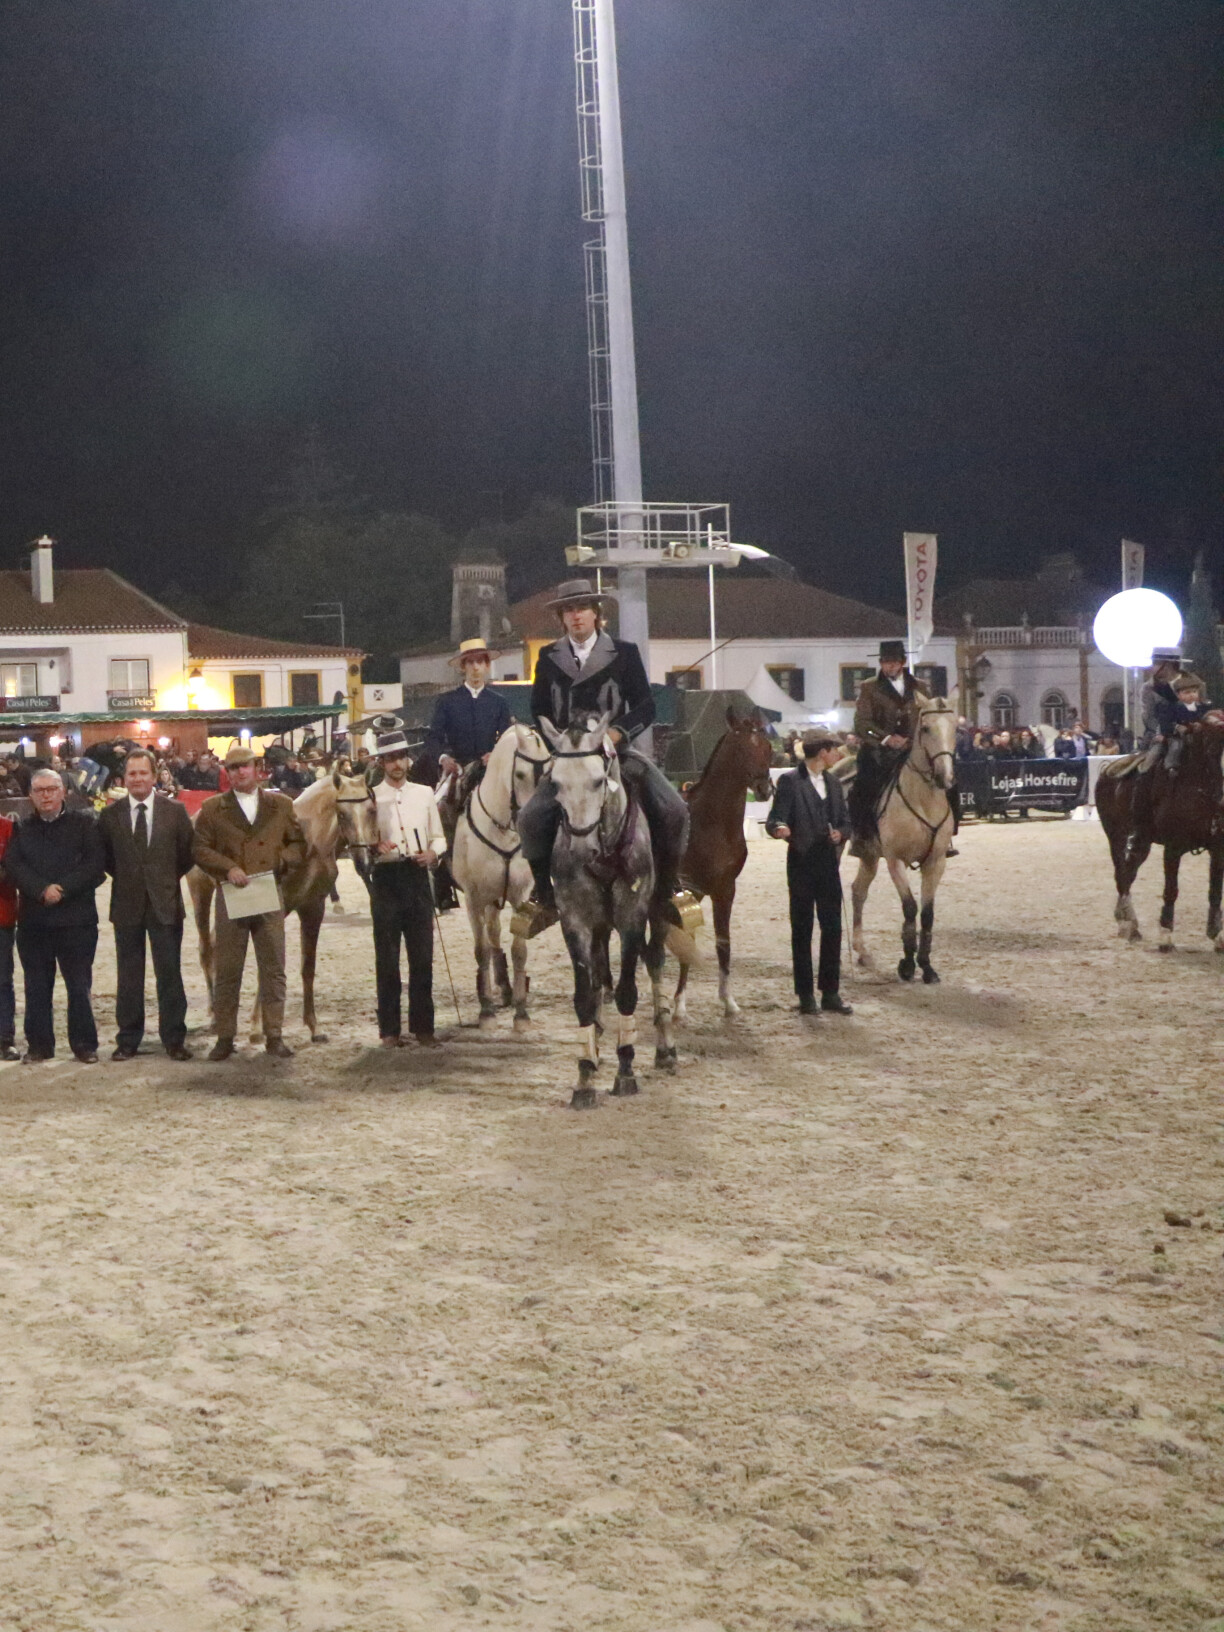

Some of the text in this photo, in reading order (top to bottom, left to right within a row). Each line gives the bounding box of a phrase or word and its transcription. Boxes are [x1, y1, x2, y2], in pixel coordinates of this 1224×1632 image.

[915, 542, 927, 621] TOYOTA
[7, 698, 25, 707] Casa
[111, 698, 130, 707] Casa
[134, 697, 154, 706] Peles
[991, 772, 1078, 792] Lojas Horsefire
